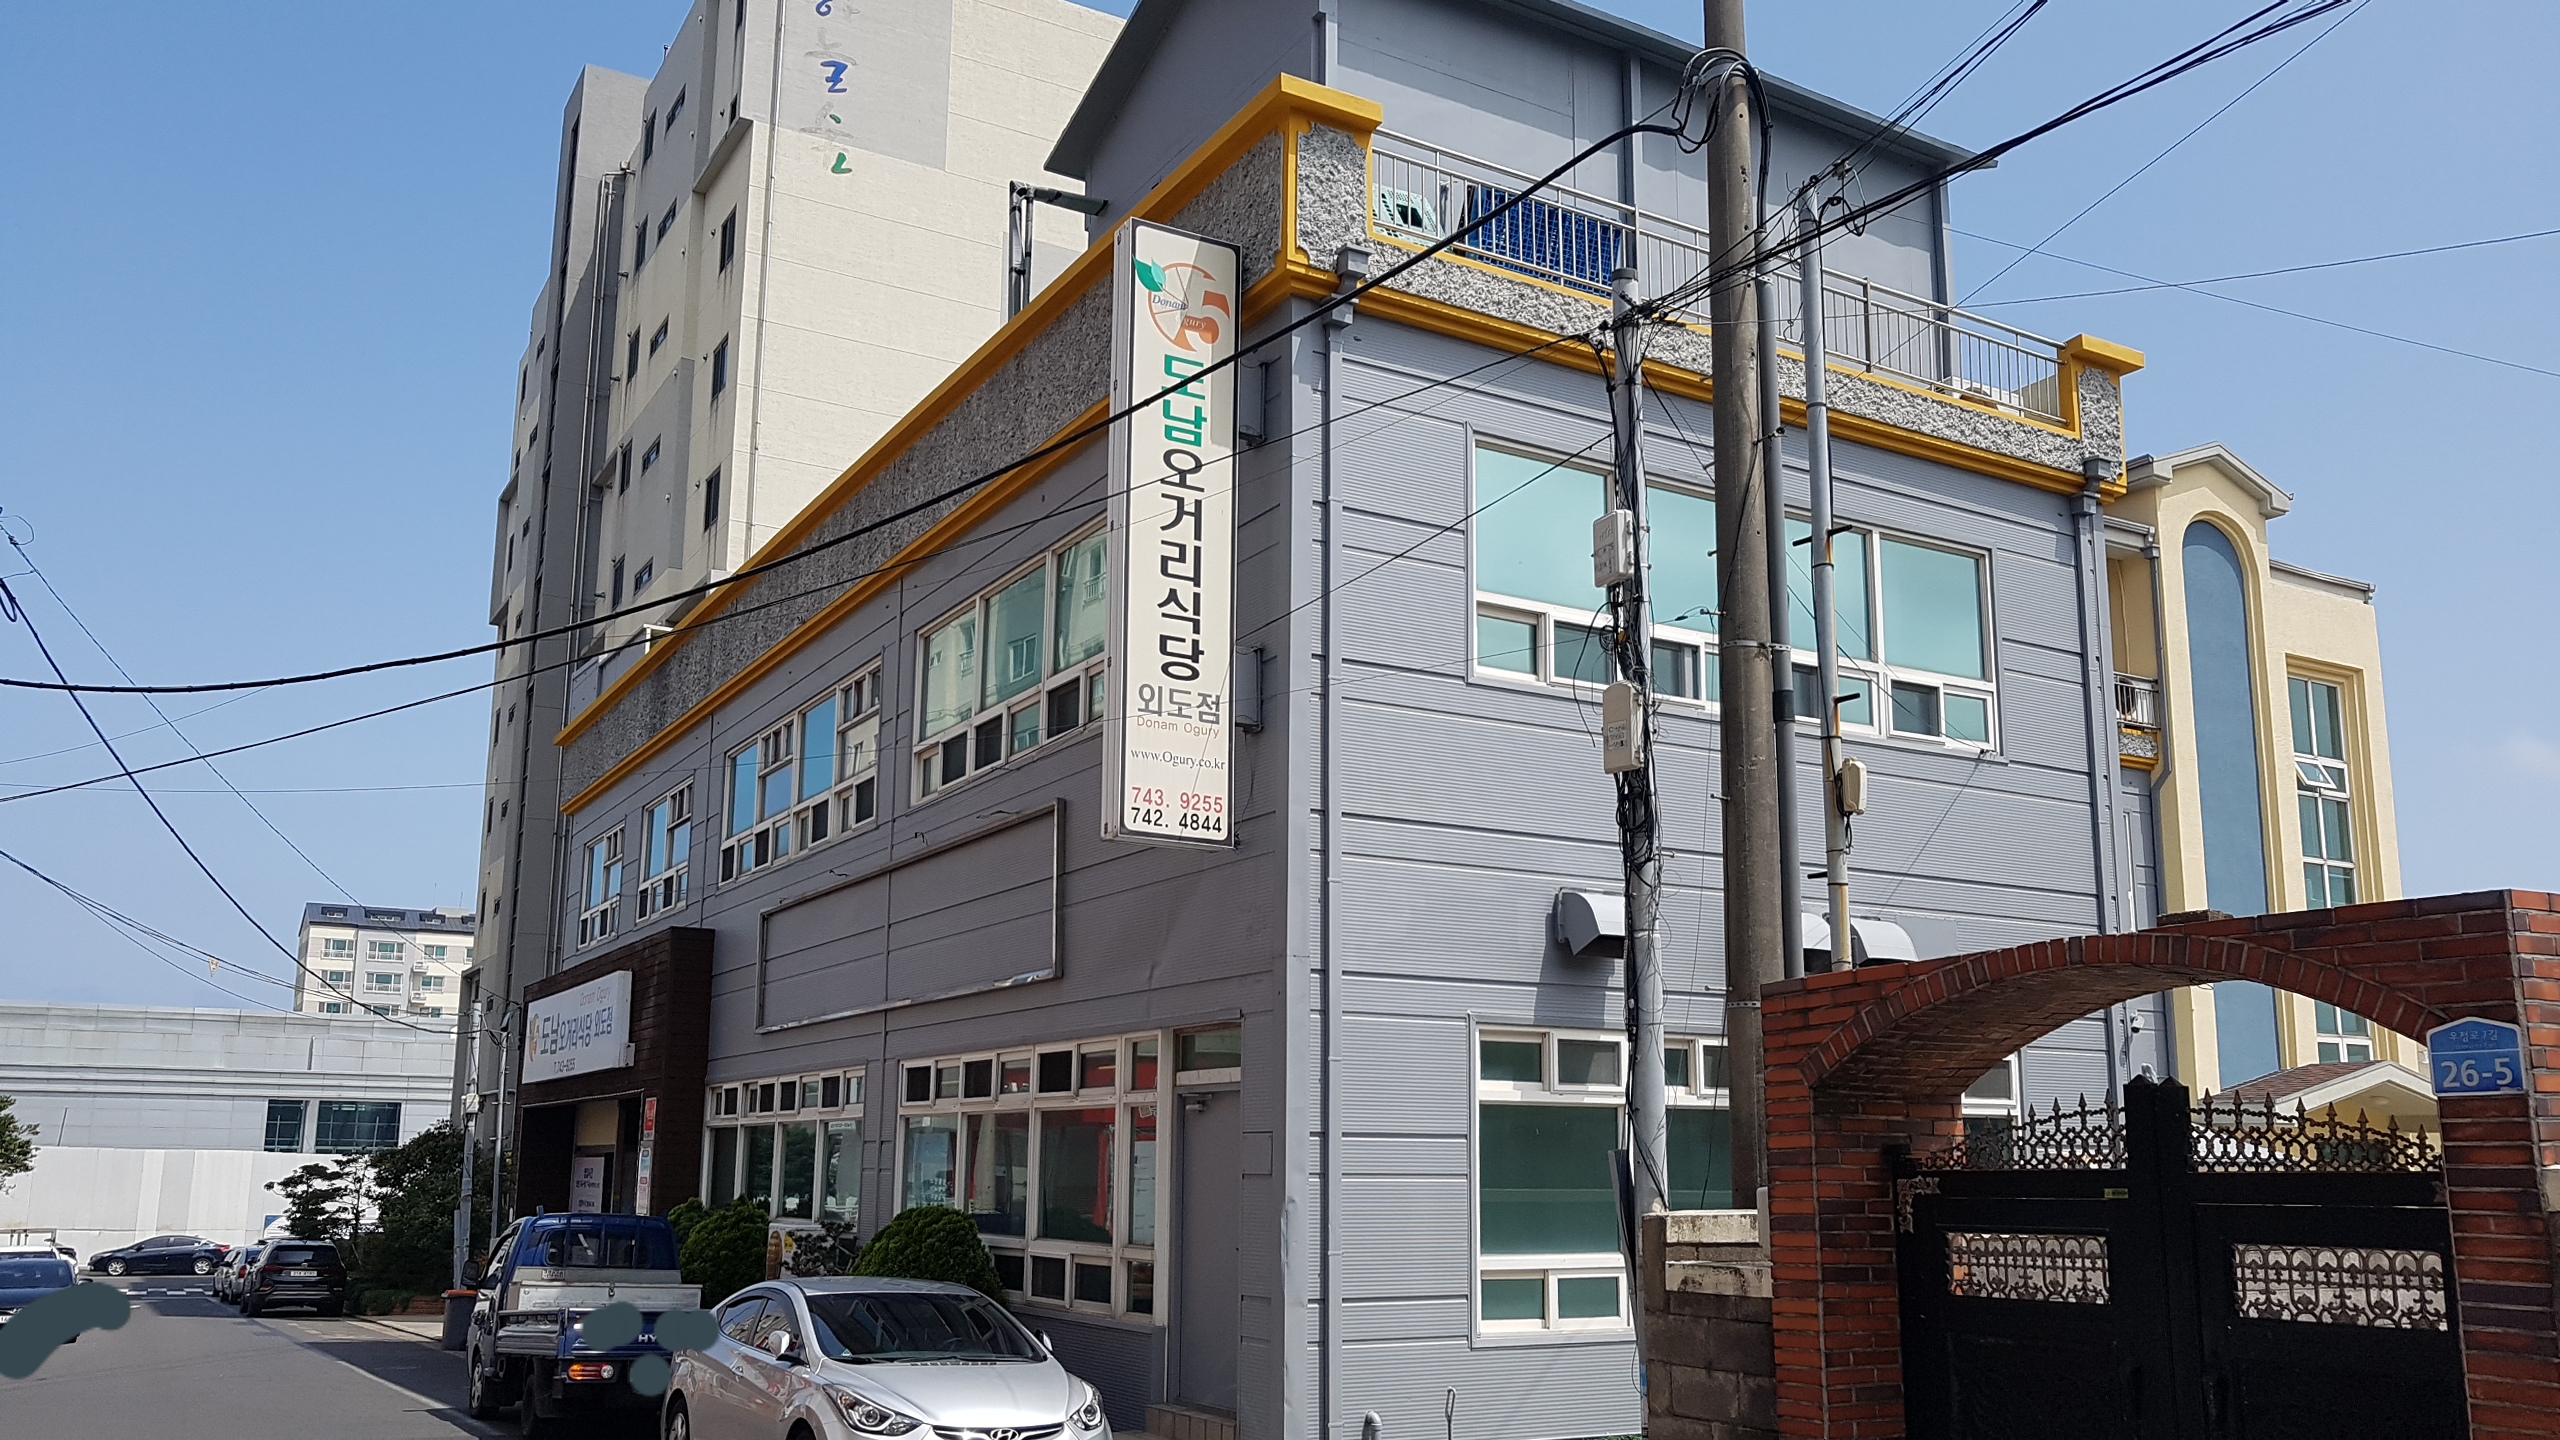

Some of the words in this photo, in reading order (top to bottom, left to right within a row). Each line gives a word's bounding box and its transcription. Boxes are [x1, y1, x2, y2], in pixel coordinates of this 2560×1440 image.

[1137, 683, 1221, 725] 외도점
[1136, 715, 1178, 732] Donam
[1183, 722, 1220, 739] Ogury
[1130, 749, 1226, 770] www.Ogury.co.kr
[1179, 791, 1223, 814] 9255
[1178, 812, 1223, 834] 4844
[594, 1006, 613, 1038] 외도점
[2441, 1057, 2513, 1088] 26-5
